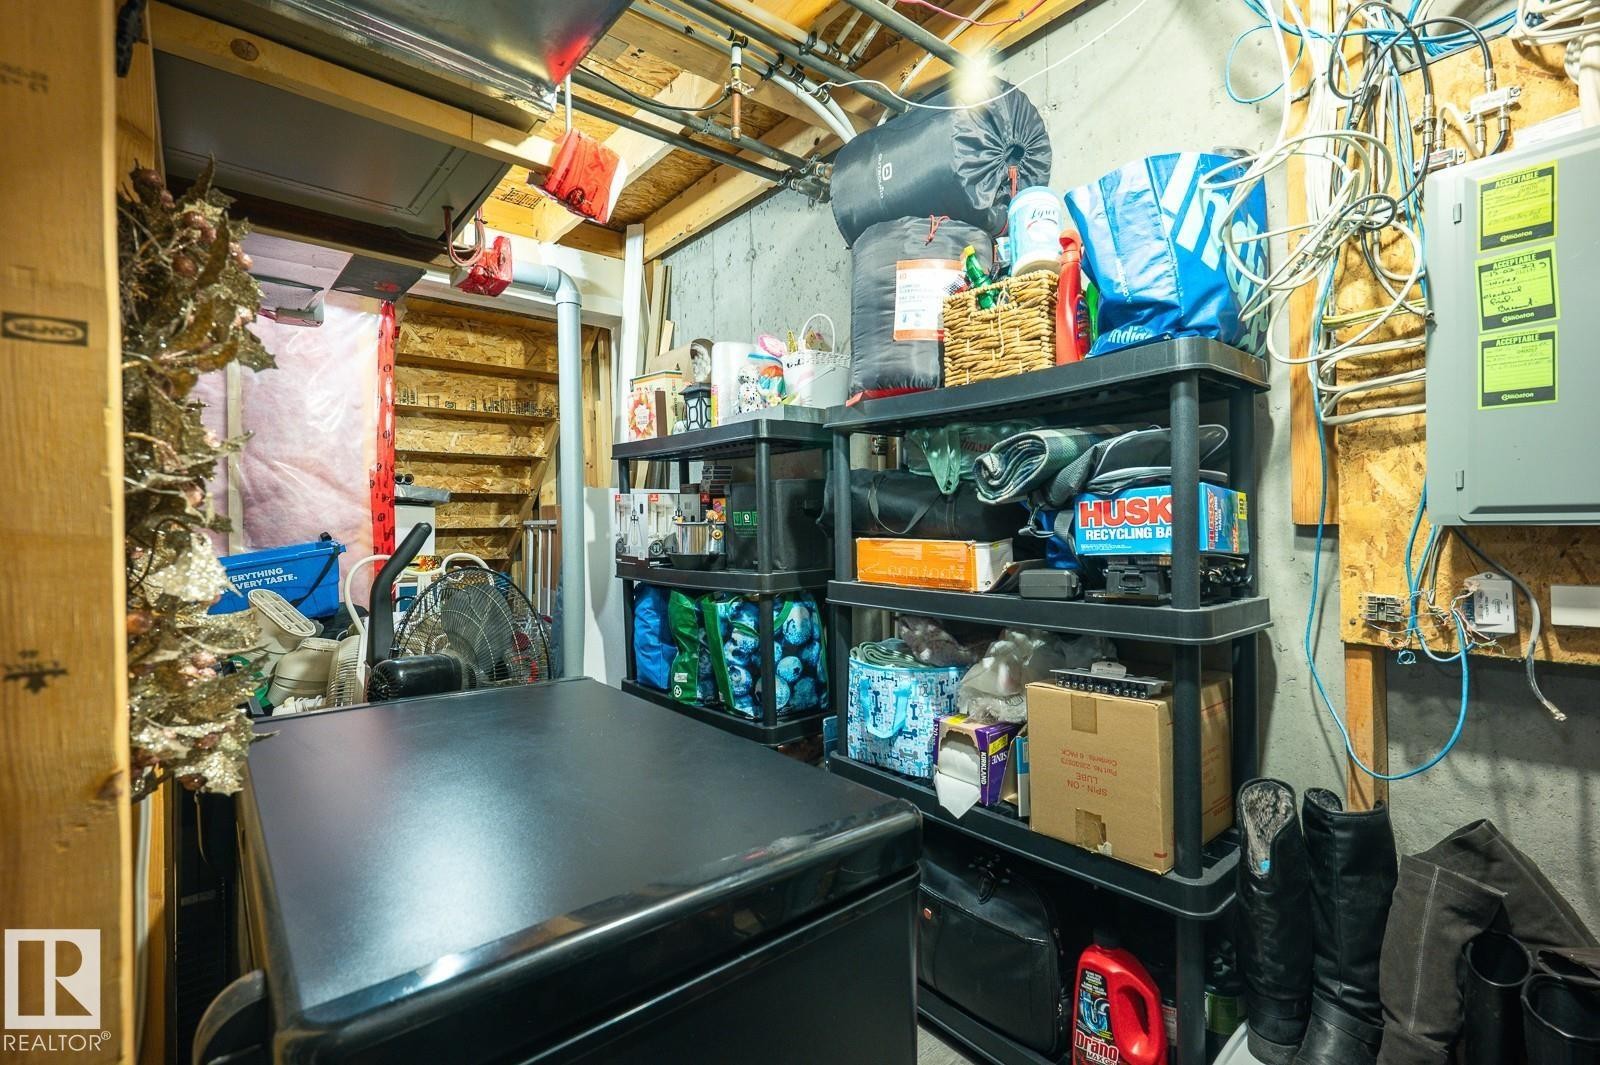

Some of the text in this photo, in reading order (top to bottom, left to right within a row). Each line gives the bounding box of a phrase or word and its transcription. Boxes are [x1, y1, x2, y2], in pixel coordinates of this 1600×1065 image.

[1495, 171, 1539, 188] ACCEPTABLE
[1493, 253, 1537, 270] ACCEPTABLE
[1496, 334, 1539, 347] ACCEPTABLE
[1078, 494, 1172, 529] HUSK
[1086, 526, 1172, 541] RECYCLING BA
[228, 567, 284, 583] ERYTHING
[236, 573, 298, 590] VERY TASTE.
[1067, 779, 1080, 790] ON
[1075, 772, 1098, 784] LUBE
[1087, 784, 1108, 797] SPIN
[1075, 1029, 1119, 1062] Drano
[1087, 1051, 1106, 1062] MAX
